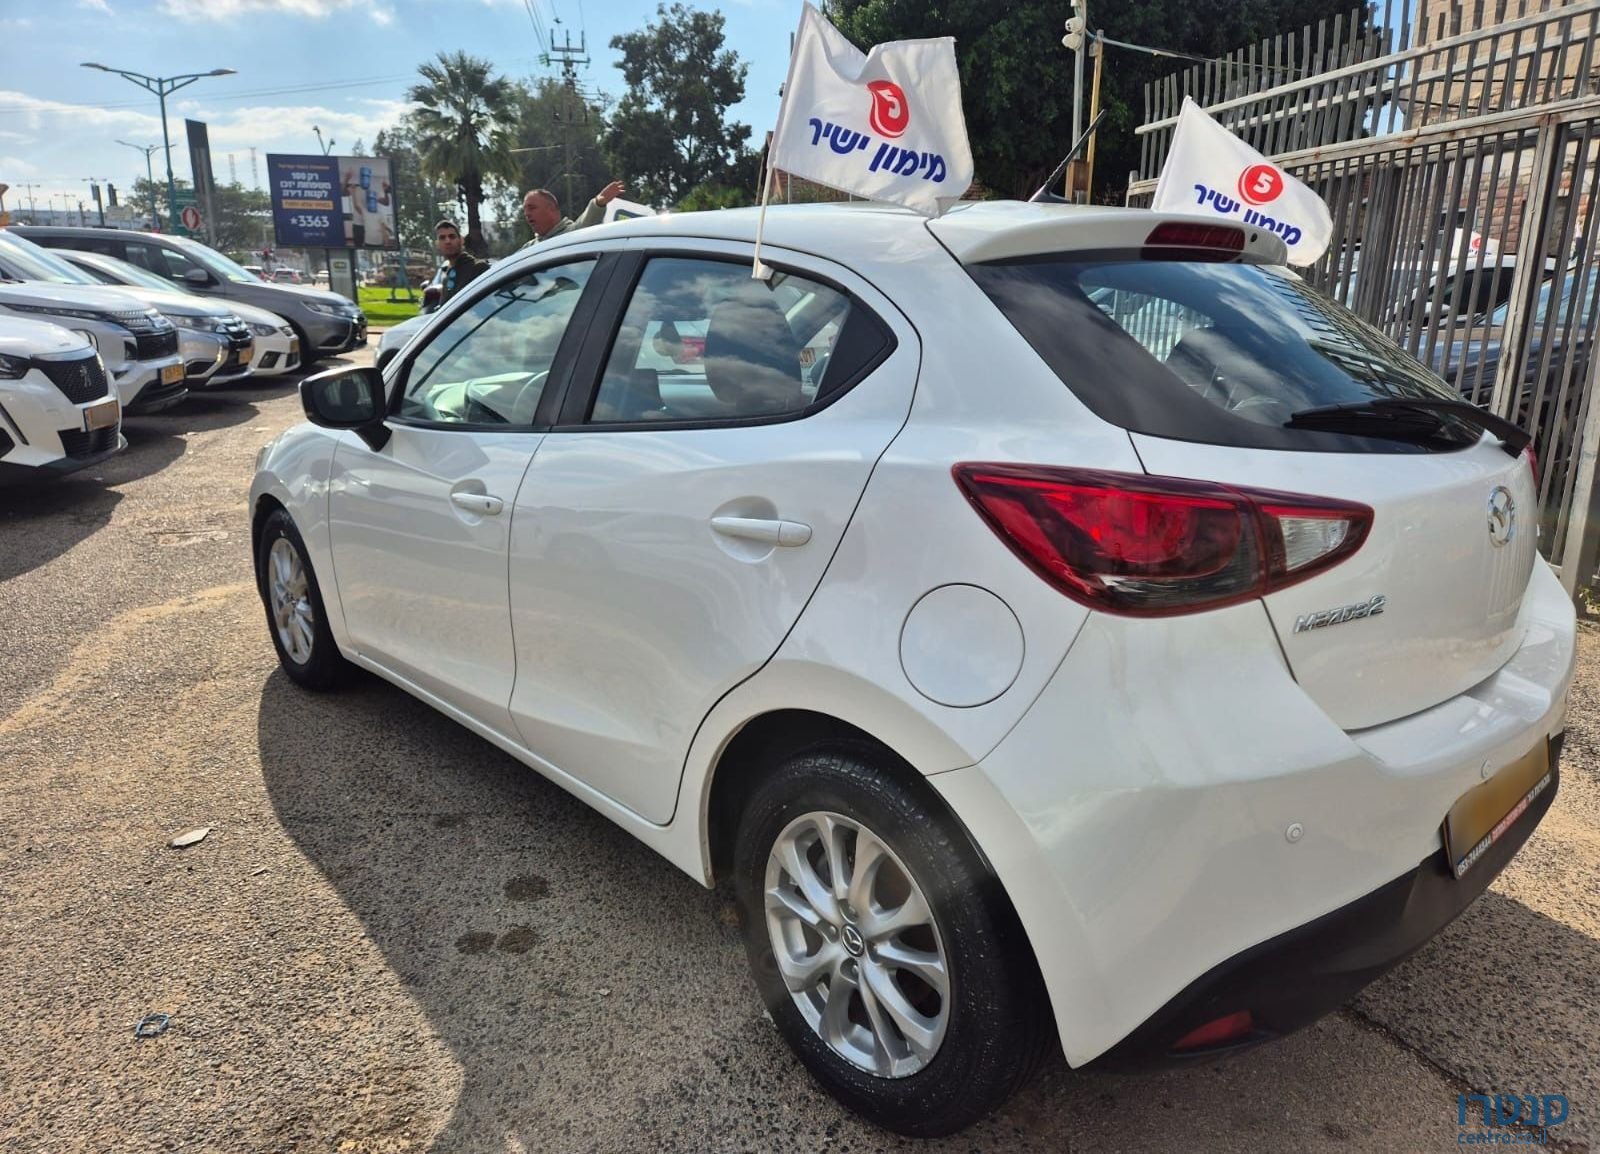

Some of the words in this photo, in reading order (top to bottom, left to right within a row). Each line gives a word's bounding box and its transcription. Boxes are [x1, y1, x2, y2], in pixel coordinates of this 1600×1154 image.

[808, 117, 871, 155] ישיר
[869, 142, 946, 183] מימון
[1194, 184, 1241, 213] ישיר
